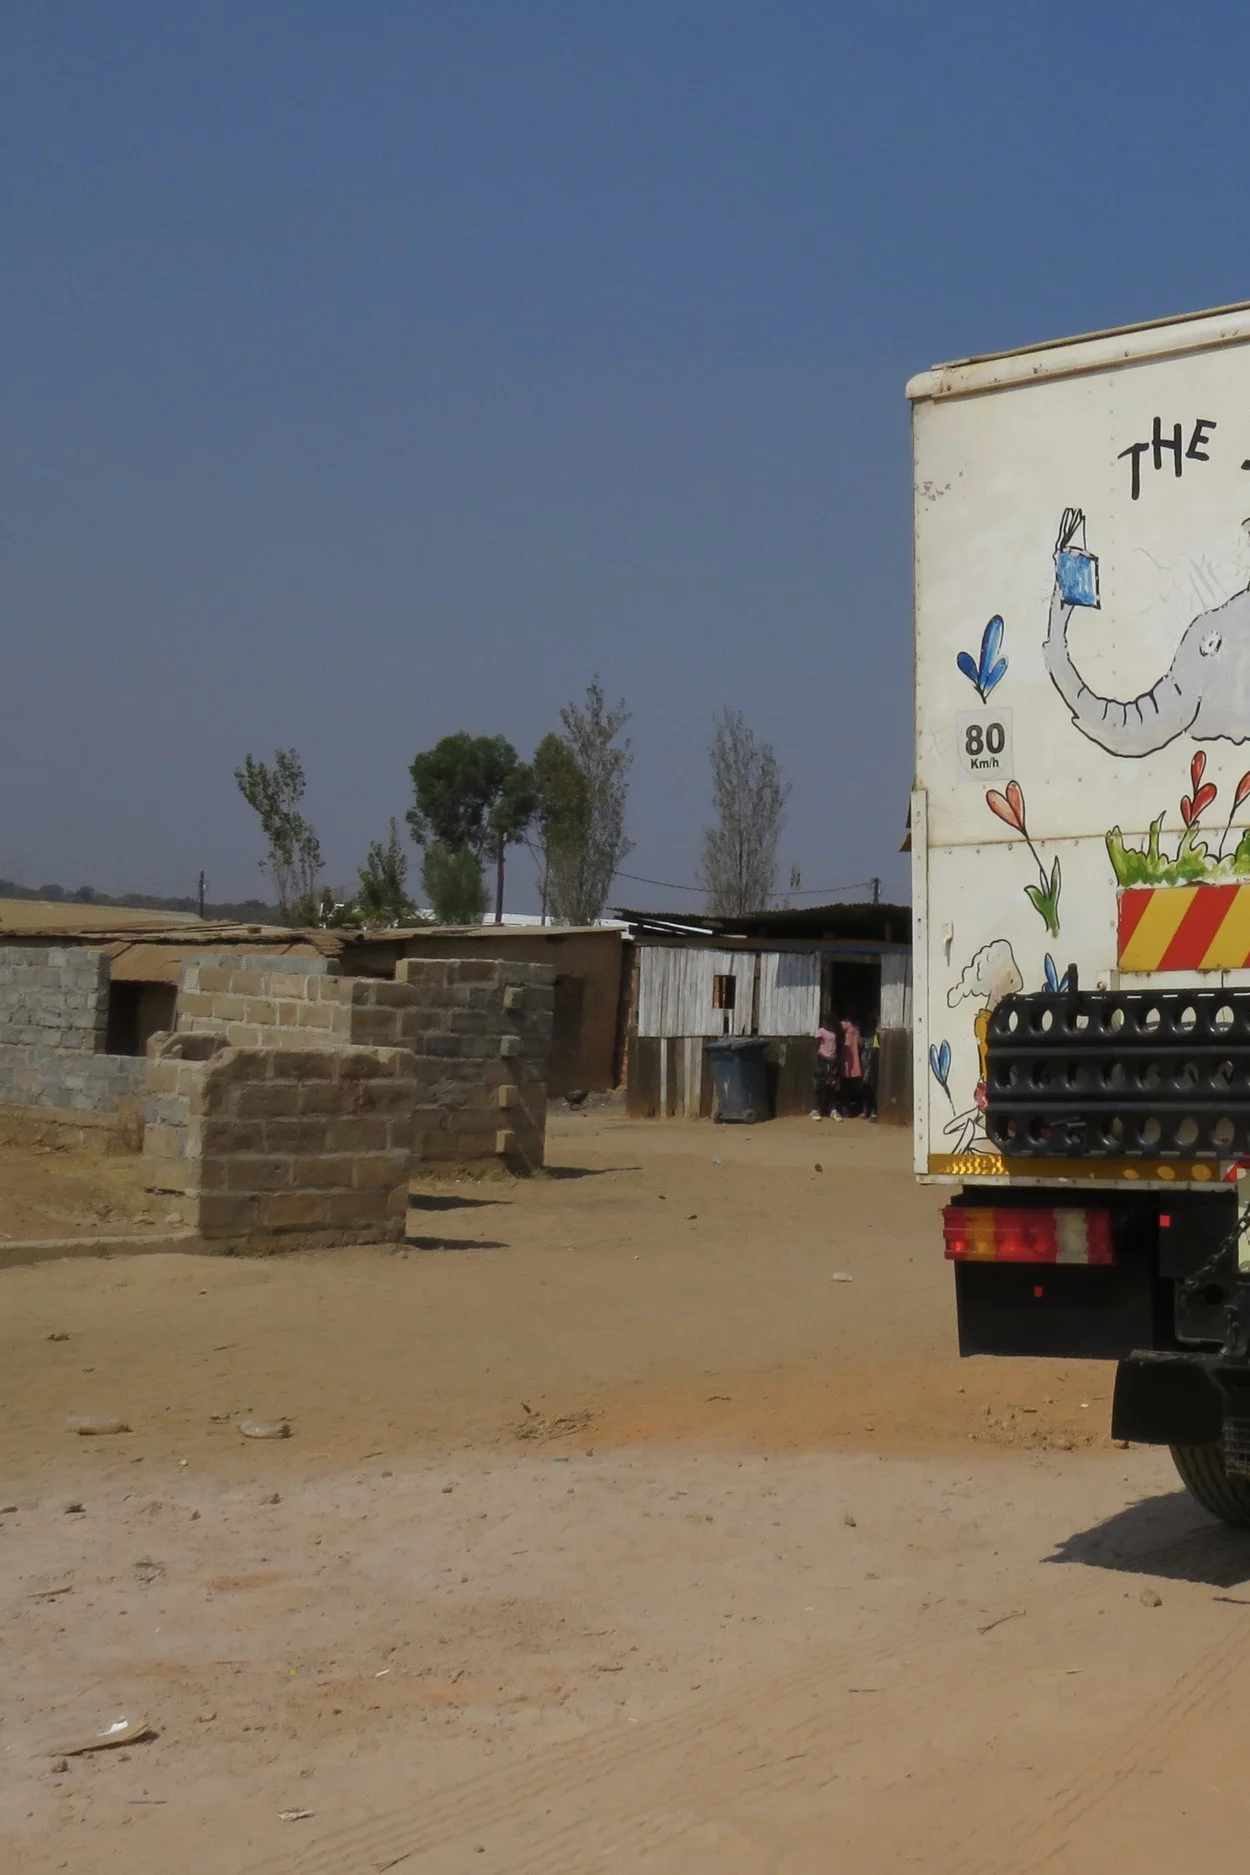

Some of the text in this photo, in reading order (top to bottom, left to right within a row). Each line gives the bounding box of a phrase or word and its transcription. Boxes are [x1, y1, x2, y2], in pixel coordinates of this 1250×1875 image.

[1117, 416, 1217, 501] THE
[965, 722, 1006, 756] 80
[970, 757, 1000, 770] Km/h
